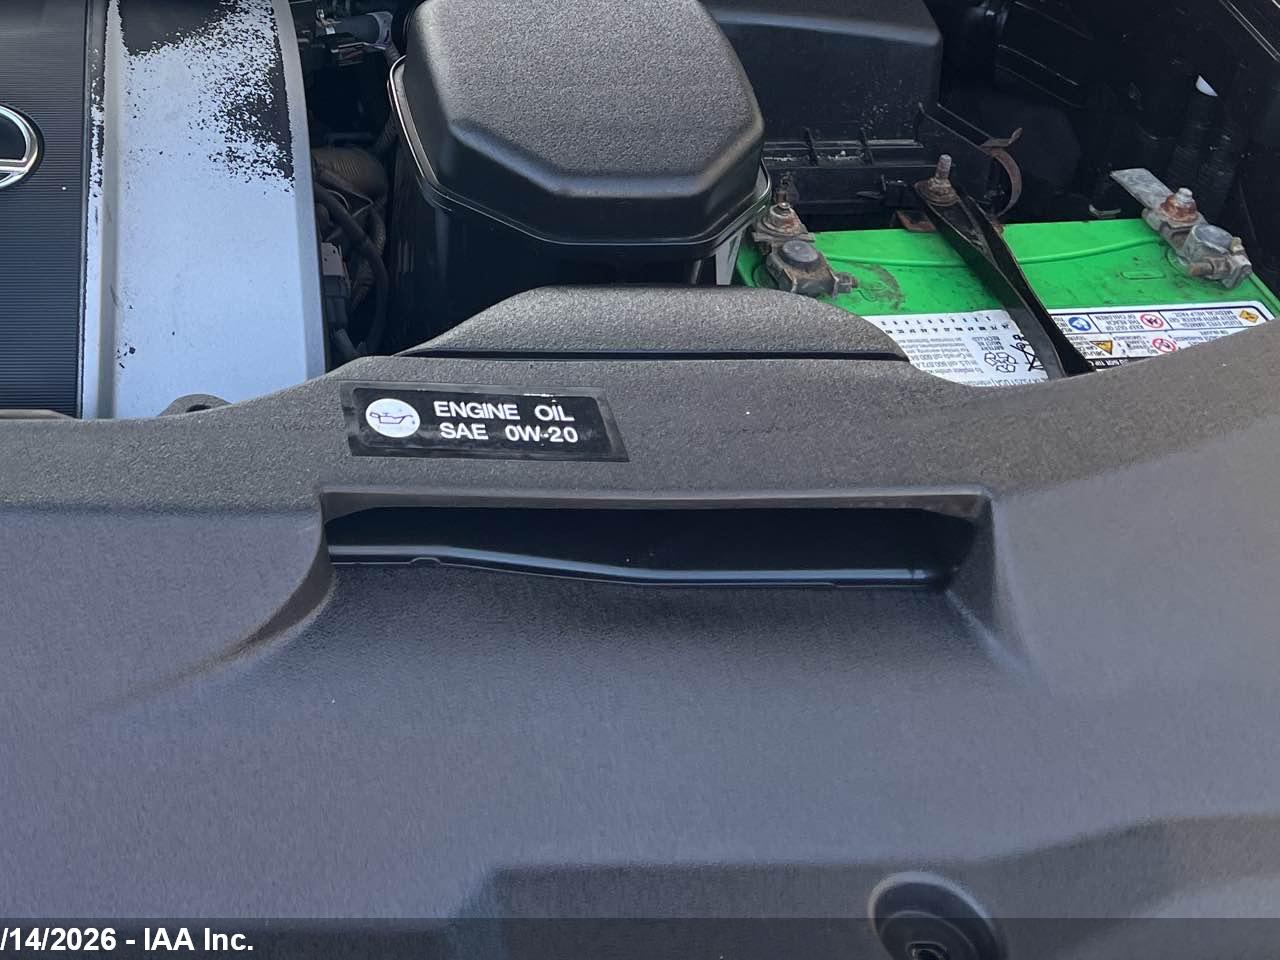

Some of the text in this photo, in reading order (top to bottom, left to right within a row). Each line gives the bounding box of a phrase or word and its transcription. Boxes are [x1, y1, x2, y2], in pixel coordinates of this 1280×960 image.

[433, 400, 575, 421] ENGINE OIL
[439, 422, 578, 443] SAE 0W-20
